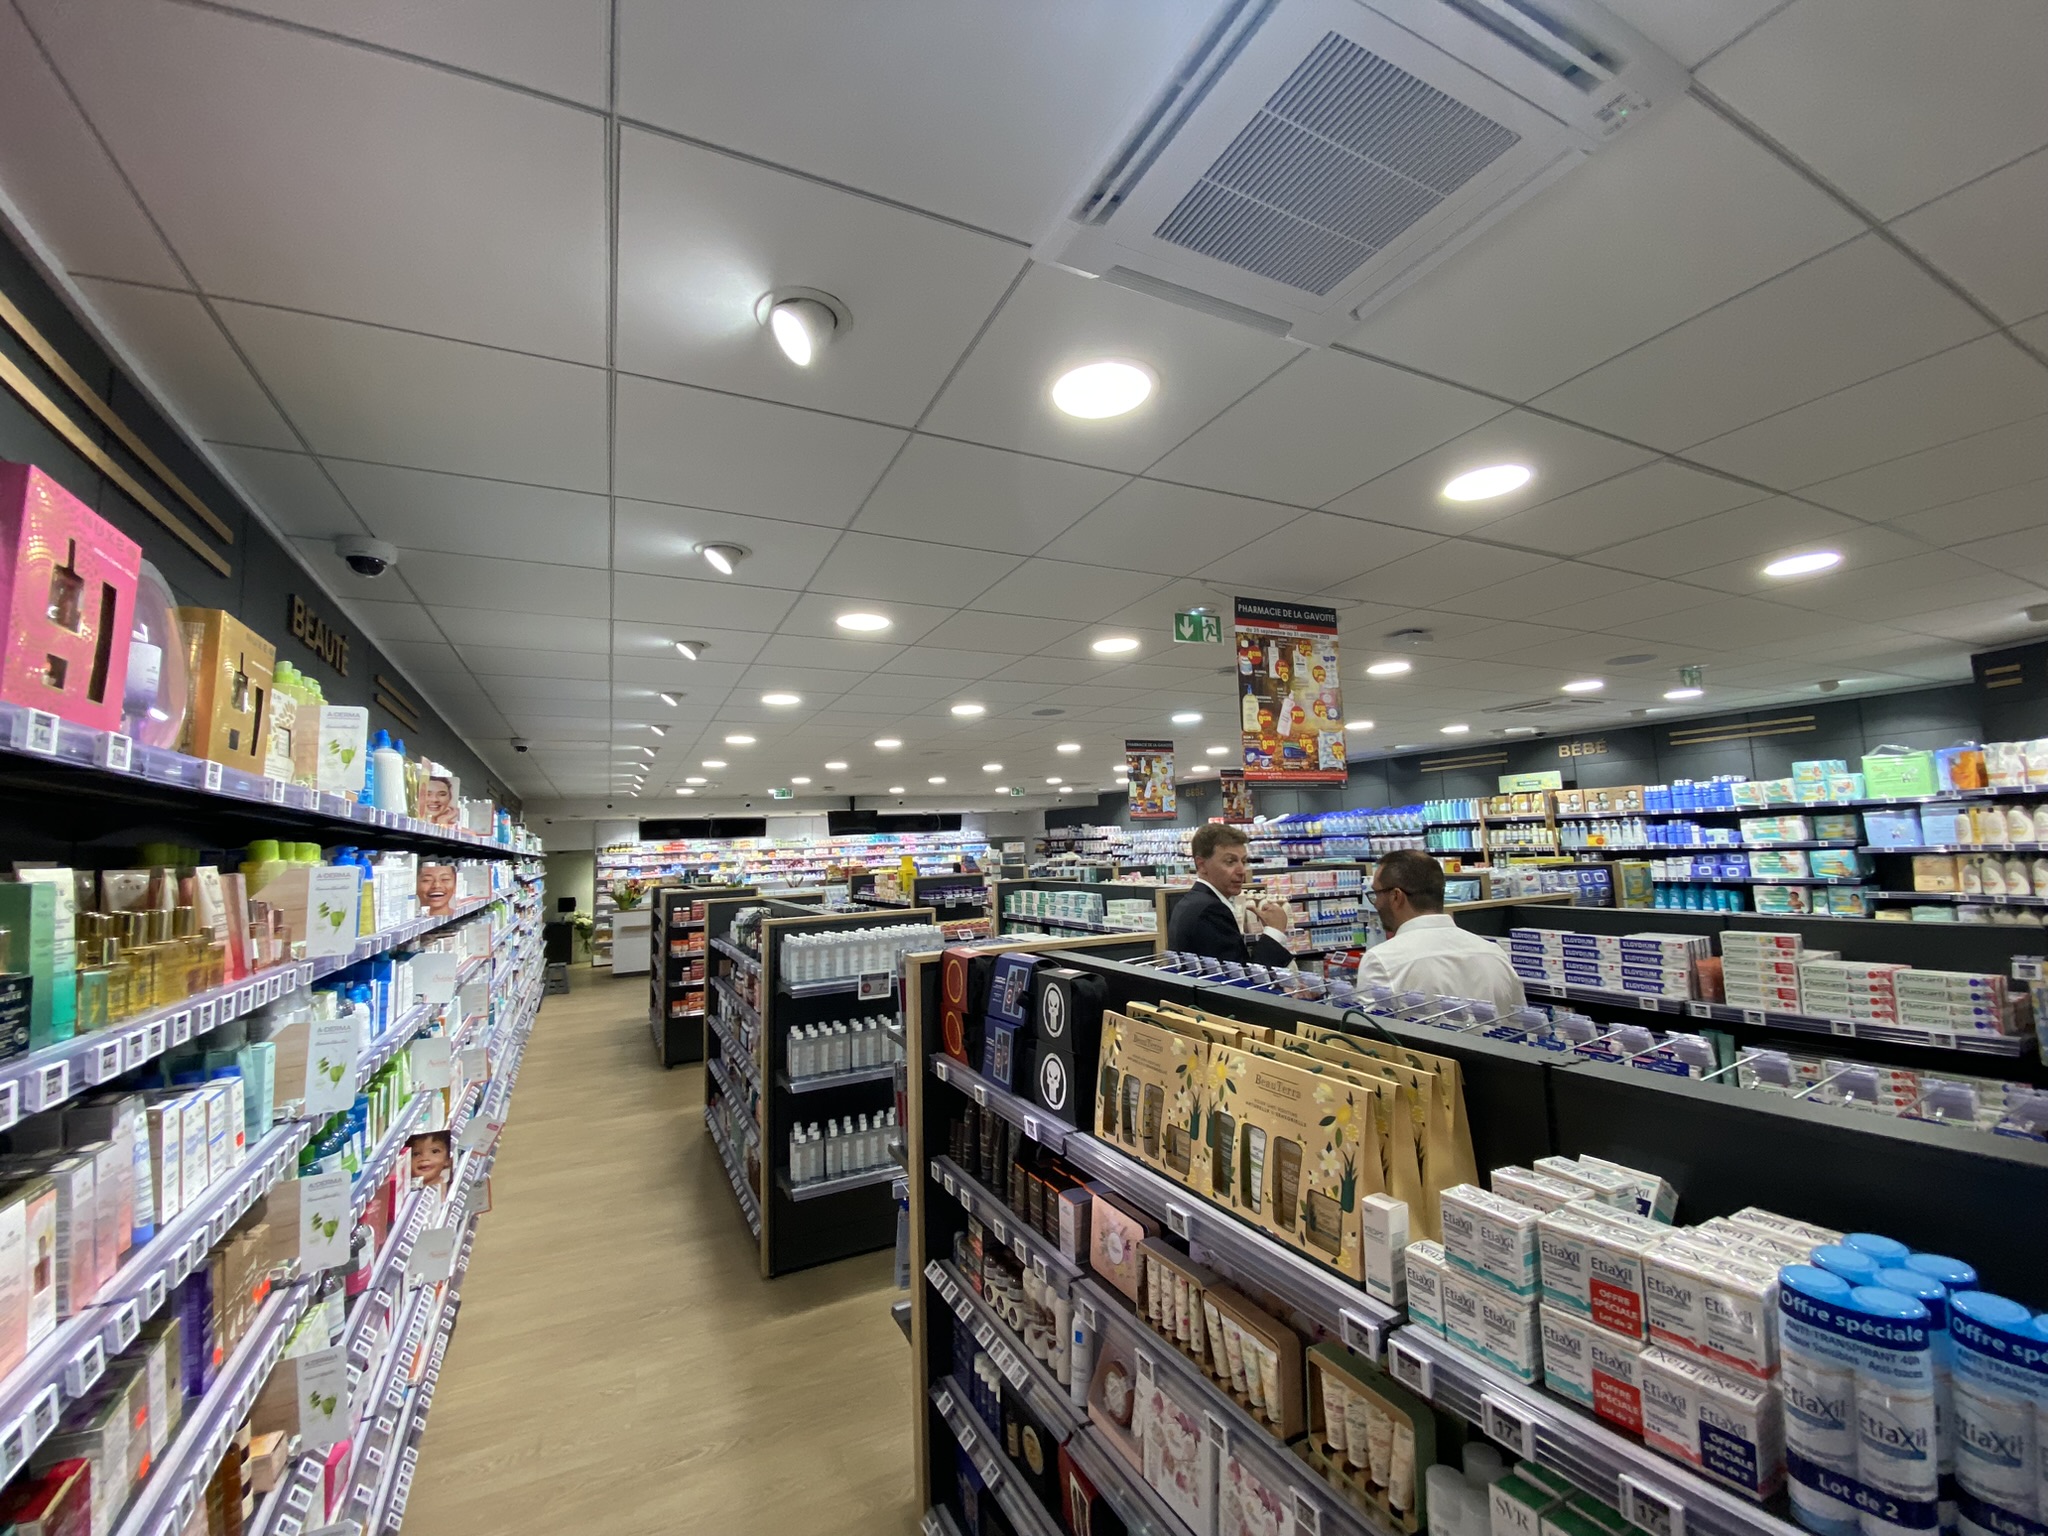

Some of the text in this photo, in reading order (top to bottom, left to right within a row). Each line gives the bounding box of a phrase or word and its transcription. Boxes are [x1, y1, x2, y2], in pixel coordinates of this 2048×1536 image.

[1238, 604, 1336, 623] PHARMACIE DE LA GAVOTTE
[291, 594, 349, 677] BEAUTÉ
[1558, 738, 1608, 758] BÉBÉ
[1255, 1074, 1301, 1099] BeauTerra
[1593, 1297, 1640, 1321] SPÉCIALE
[1599, 1289, 1631, 1306] OFFRE
[1627, 1321, 1635, 1331] 2
[1781, 1290, 1924, 1343] Offre spéciale
[1952, 1316, 2007, 1353] Offre
[1596, 1389, 1640, 1416] SPÉCIALE
[1600, 1381, 1632, 1400] OFFRE
[1628, 1415, 1635, 1425] 2
[1703, 1441, 1755, 1470] SPÉCIALE
[1709, 1433, 1747, 1456] OFFRE
[1710, 1457, 1749, 1481] Lot de 2
[1818, 1472, 1900, 1519] Lot de 2
[1496, 1496, 1529, 1529] SVR
